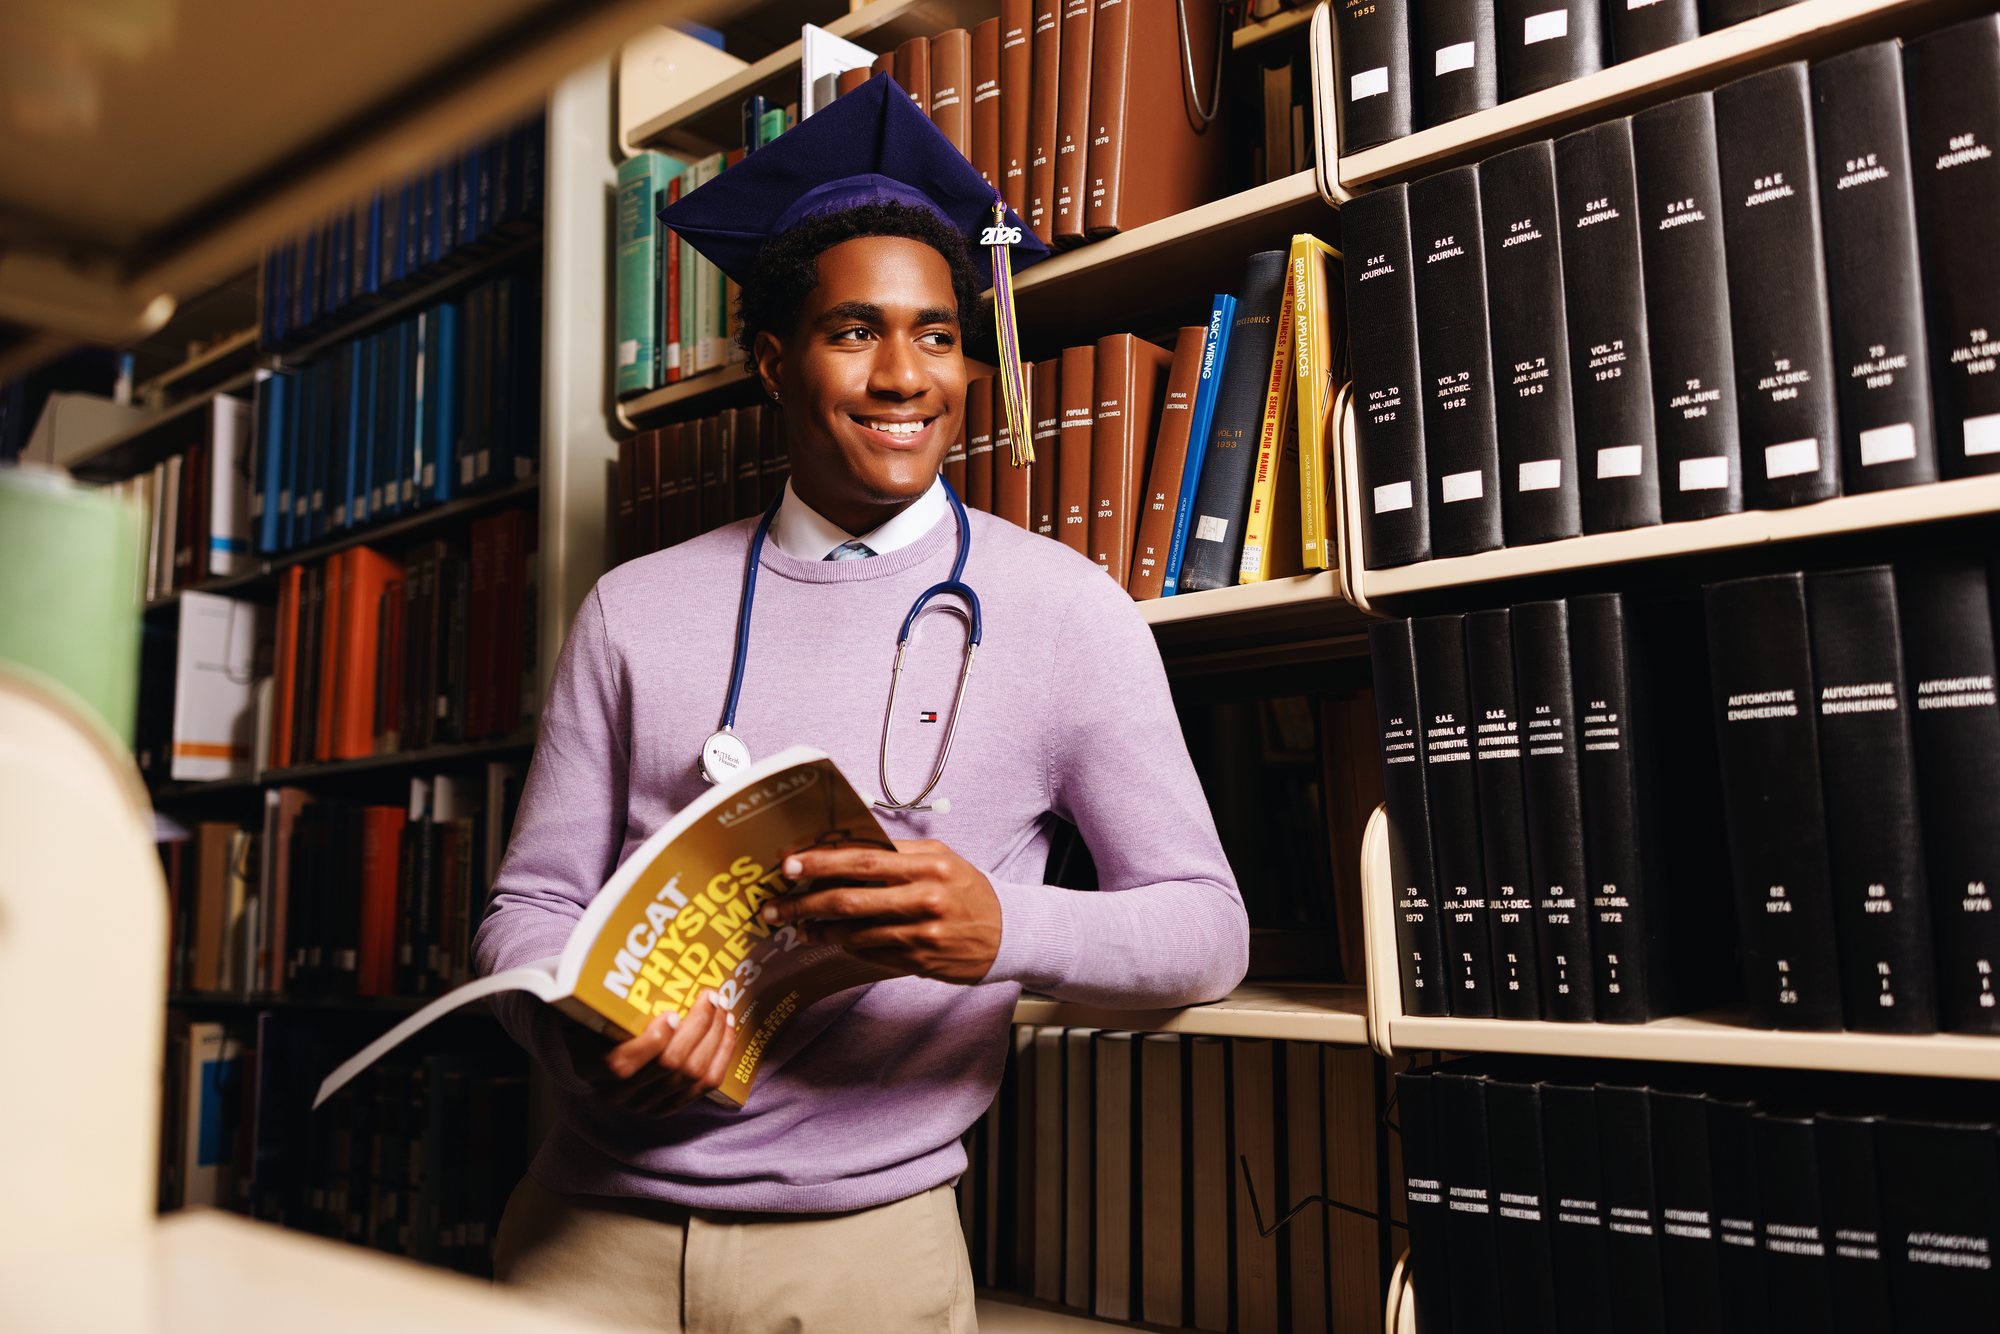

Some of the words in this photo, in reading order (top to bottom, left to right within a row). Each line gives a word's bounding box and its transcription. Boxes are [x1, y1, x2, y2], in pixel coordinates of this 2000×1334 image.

[1353, 5, 1376, 18] 1955
[1095, 136, 1110, 146] 1976
[1935, 144, 1992, 170] JOURNAL
[1837, 166, 1890, 190] JOURNAL
[1745, 185, 1794, 207] JOURNAL
[1586, 198, 1608, 212] SAE
[1577, 209, 1619, 227] JOURNAL
[1659, 211, 1705, 230] JOURNAL
[1510, 219, 1531, 232] SAE
[980, 227, 1022, 245] 2026
[1435, 236, 1454, 249] SAE
[1502, 230, 1541, 248] JOURNAL
[1367, 254, 1385, 267] SAE
[1426, 247, 1464, 263] JOURNAL
[1359, 265, 1394, 281] JOURNAL
[1295, 256, 1307, 312] REPAIRING
[1209, 310, 1222, 340] BASIC
[1278, 300, 1293, 348] APPLIANCES:
[1297, 315, 1309, 378] APPLIANCES
[1590, 343, 1611, 356] VOL.
[1613, 340, 1623, 350] 71
[1202, 342, 1217, 379] WIRING
[1514, 360, 1533, 373] VOL.
[1535, 358, 1545, 367] 71
[1774, 359, 1791, 372] 72
[1271, 358, 1284, 393] COMMON
[1437, 375, 1456, 386] VOL.
[1457, 371, 1469, 381] 70
[1595, 368, 1621, 382] 1963
[1519, 384, 1543, 397] 1963
[1686, 379, 1700, 390] 72
[1369, 390, 1386, 400] VOL.
[1388, 387, 1399, 396] 70
[1771, 387, 1798, 402] 1964
[1101, 400, 1118, 408] POPULAR
[1267, 395, 1279, 420] SENSE
[1442, 398, 1466, 411] 1962
[1066, 408, 1089, 417] POPULAR
[1374, 413, 1396, 424] 1962
[1683, 406, 1708, 419] 1964
[1062, 418, 1094, 429] ELECTRONICS
[1234, 430, 1243, 438] 11
[1263, 422, 1275, 449] REPAIR
[1257, 452, 1270, 484] MANUAL
[1070, 505, 1079, 513] 32
[1101, 499, 1110, 507] 33
[1153, 503, 1164, 511] 1971
[1067, 516, 1083, 524] 1970
[1098, 510, 1113, 518] 1970
[1147, 547, 1154, 555] TK
[1822, 681, 1895, 701] AUTOMOTIVE
[1918, 675, 1994, 694] AUTOMOTIVE
[1728, 689, 1795, 707] AUTOMOTIVE
[1918, 691, 1997, 710] ENGINEERING
[1728, 704, 1798, 721] ENGINEERING
[1822, 698, 1898, 715] ENGINEERING
[1435, 714, 1455, 723] S.A.E.
[1486, 709, 1506, 720] S.A.E.
[1584, 715, 1607, 724] JOURNAL
[1608, 714, 1617, 722] OF
[1478, 723, 1506, 734] JOURNAL
[1507, 722, 1517, 731] OF
[1528, 720, 1552, 729] JOURNAL
[1552, 718, 1561, 726] OF
[1385, 730, 1405, 739] JOURNAL
[1427, 727, 1455, 738] JOURNAL
[1457, 726, 1466, 735] OF
[1529, 732, 1563, 742] AUTOMOTIVE
[1584, 727, 1619, 738] AUTOMOTIVE
[1385, 742, 1415, 752] AUTOMOTIVE
[1428, 739, 1468, 750] AUTOMOTIVE
[1478, 735, 1519, 746] AUTOMOTIVE
[1387, 755, 1415, 764] ENGINEERING
[1429, 751, 1471, 763] ENGINEERING
[716, 771, 808, 824] KAPLAN
[1406, 887, 1418, 896] 78
[1455, 886, 1467, 896] 79
[1501, 886, 1514, 896] 79
[1550, 885, 1563, 897] 80
[1602, 884, 1616, 895] 80
[1443, 899, 1485, 910] JAN.-JUNE
[1489, 899, 1532, 910] JULY-DEC.
[1766, 900, 1792, 913] 1974
[1405, 913, 1424, 923] 1970
[1455, 913, 1473, 923] 1971
[1500, 913, 1520, 923] 1971
[1548, 914, 1570, 924] 1972
[1600, 912, 1622, 923] 1972
[603, 876, 689, 999] MCAT
[627, 856, 764, 1016] PHYSICS
[652, 942, 710, 1018] AND
[708, 869, 790, 940] MAT
[1413, 952, 1422, 961] TL
[1463, 952, 1473, 962] TL
[1507, 953, 1517, 964] TL
[739, 1000, 759, 1025] BOOK
[734, 1027, 765, 1081] HIGHER
[763, 990, 800, 1027] SCORE
[741, 1003, 797, 1084] GUARANTEED
[1450, 1187, 1487, 1199] AUTOMOTIVE
[1500, 1192, 1539, 1206] AUTOMOTIVE
[1450, 1200, 1489, 1214] ENGINEERING
[1560, 1198, 1598, 1211] AUTOMOTIVE
[1500, 1207, 1541, 1221] ENGINEERING
[1559, 1212, 1601, 1226] ENGINEERING
[1907, 1231, 1990, 1252] AUTOMOTIVE
[1907, 1248, 1992, 1270] ENGINEERING
